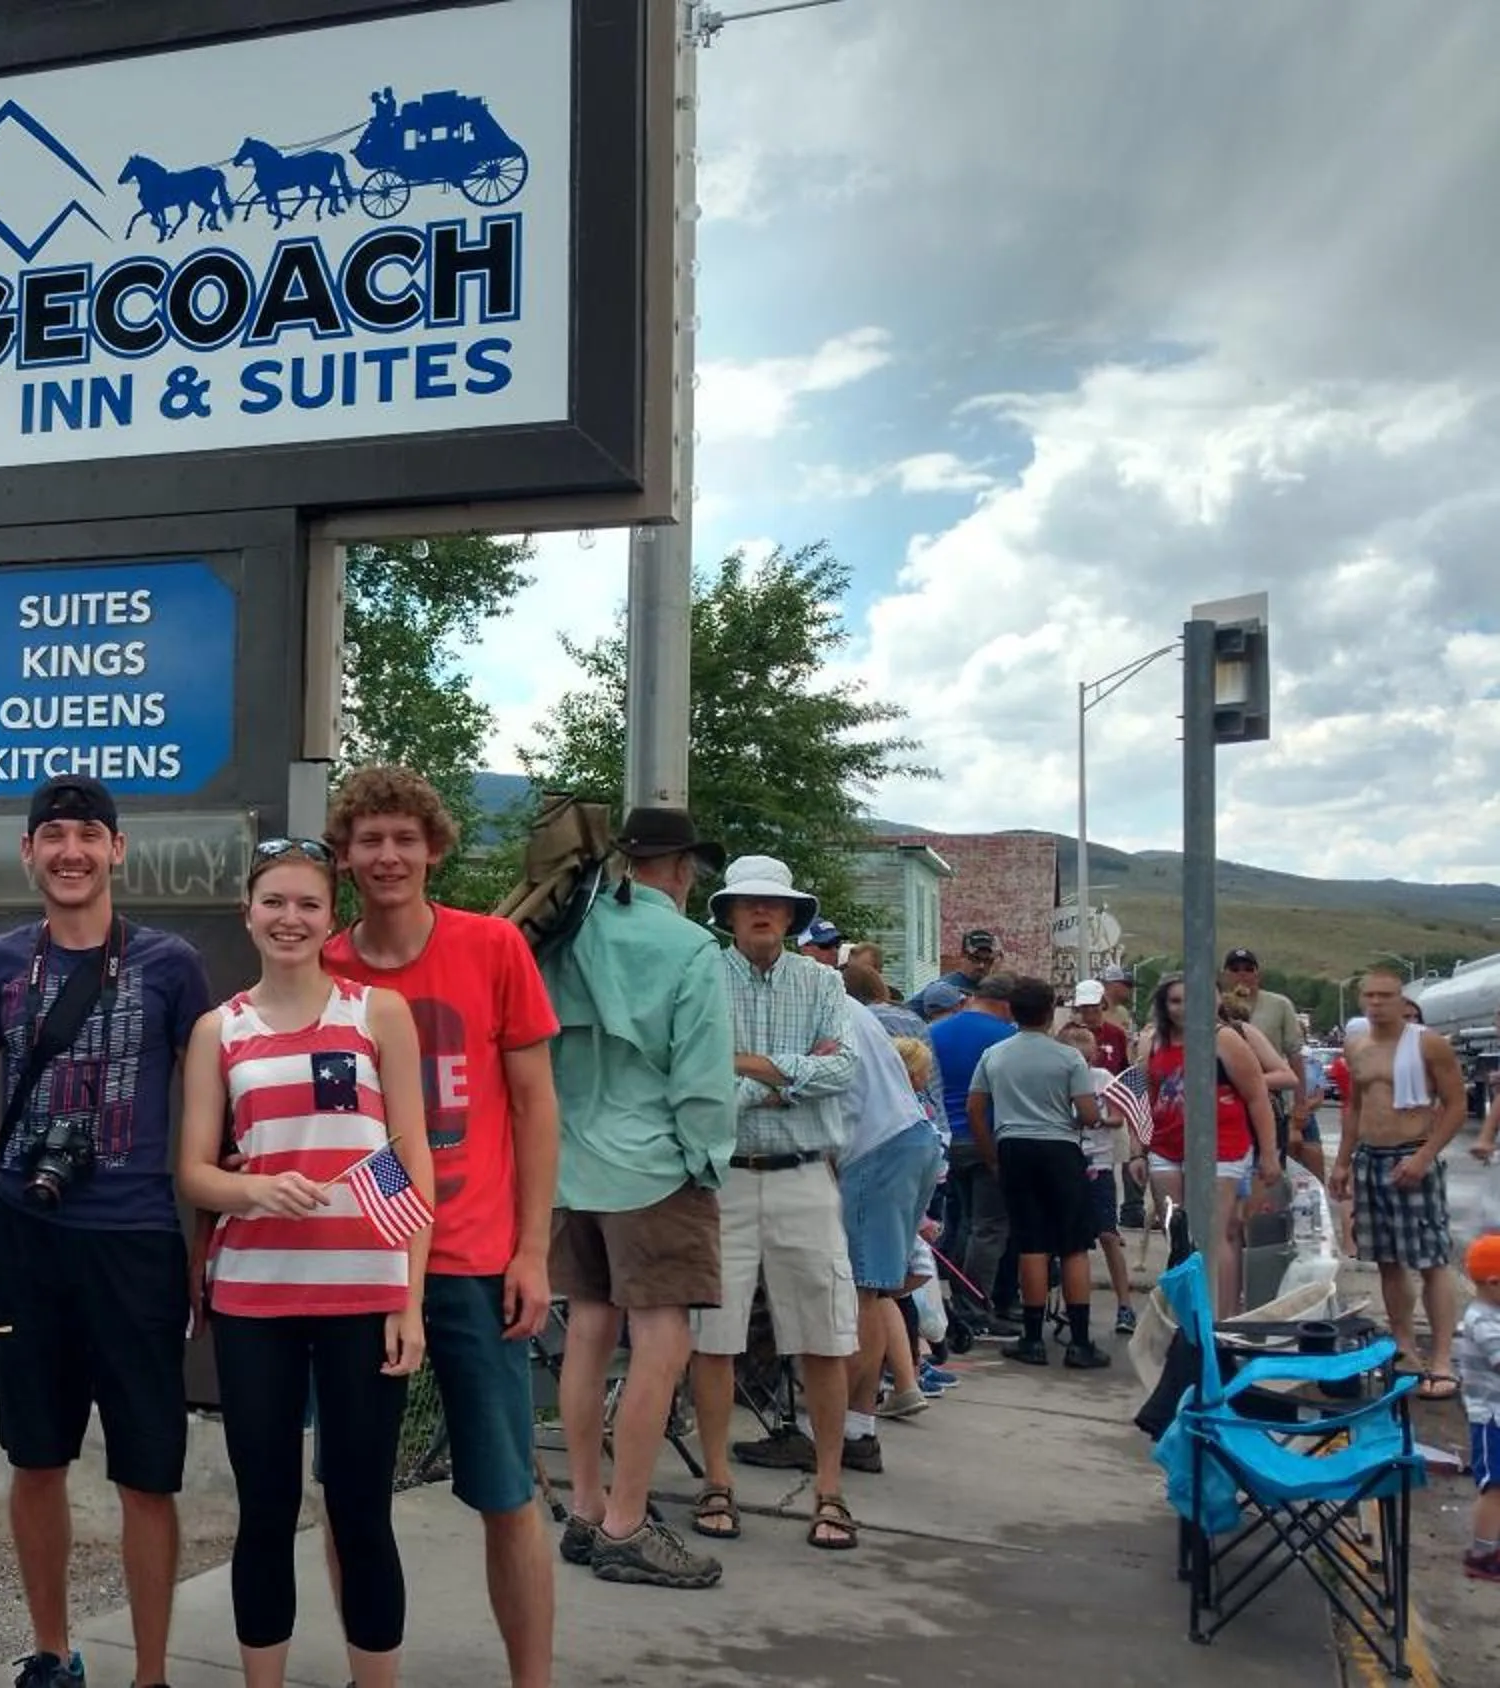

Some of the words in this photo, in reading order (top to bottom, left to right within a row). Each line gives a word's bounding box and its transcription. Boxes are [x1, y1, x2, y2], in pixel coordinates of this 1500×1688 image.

[20, 374, 134, 434] INN
[159, 365, 212, 419] &
[239, 338, 513, 415] SUITES
[19, 590, 152, 629] SUITES
[22, 642, 146, 678] KINGS
[0, 693, 166, 729] QUEENS
